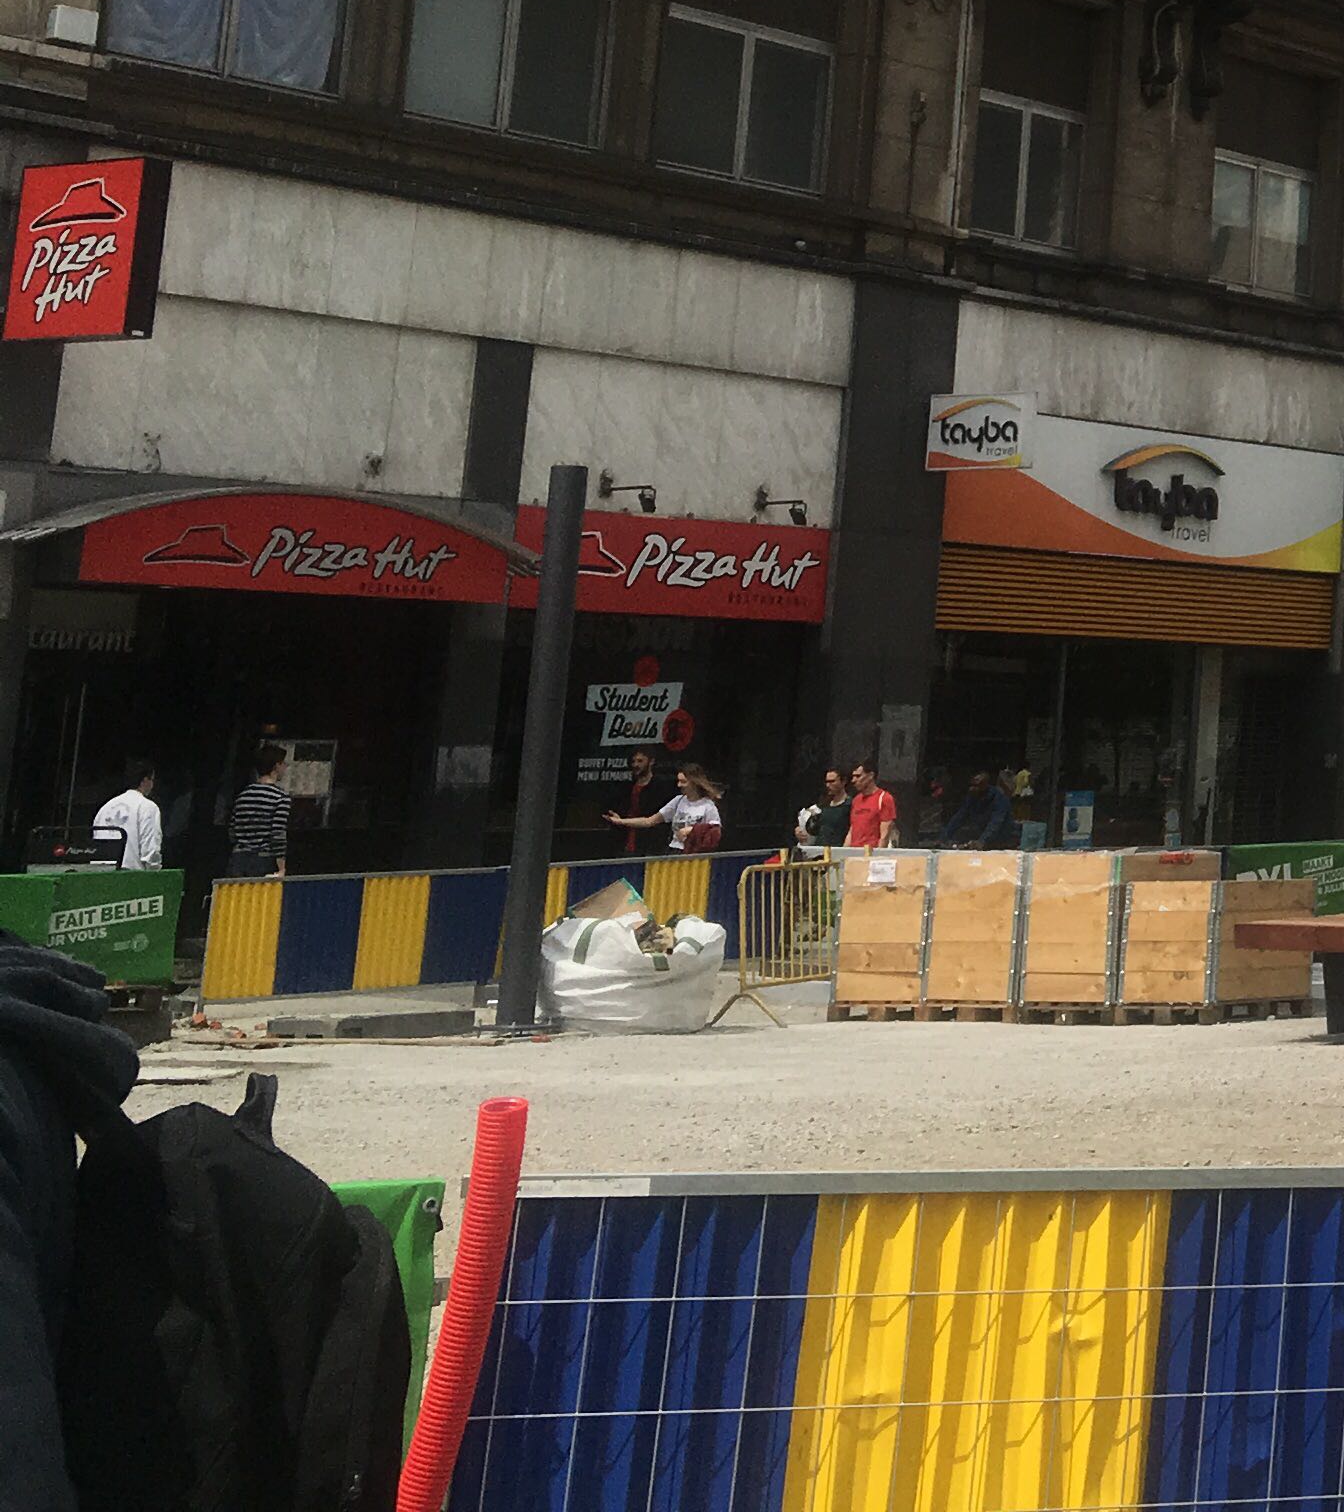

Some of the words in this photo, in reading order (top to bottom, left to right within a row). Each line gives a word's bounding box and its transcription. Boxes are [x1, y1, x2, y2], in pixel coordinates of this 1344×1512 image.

[22, 228, 117, 291] Pizza
[35, 265, 111, 323] Hut
[940, 416, 1018, 453] tayba
[1115, 469, 1219, 531] tayba
[1171, 522, 1211, 542] travel
[251, 525, 368, 578] Pizza
[372, 535, 457, 582] Hut
[625, 533, 738, 588] Pizza
[741, 541, 821, 590] Hut
[594, 686, 669, 712] Student
[608, 714, 658, 739] Deals
[55, 909, 98, 930] FAIT
[101, 899, 160, 921] BELLE
[70, 928, 107, 942] VOUS
